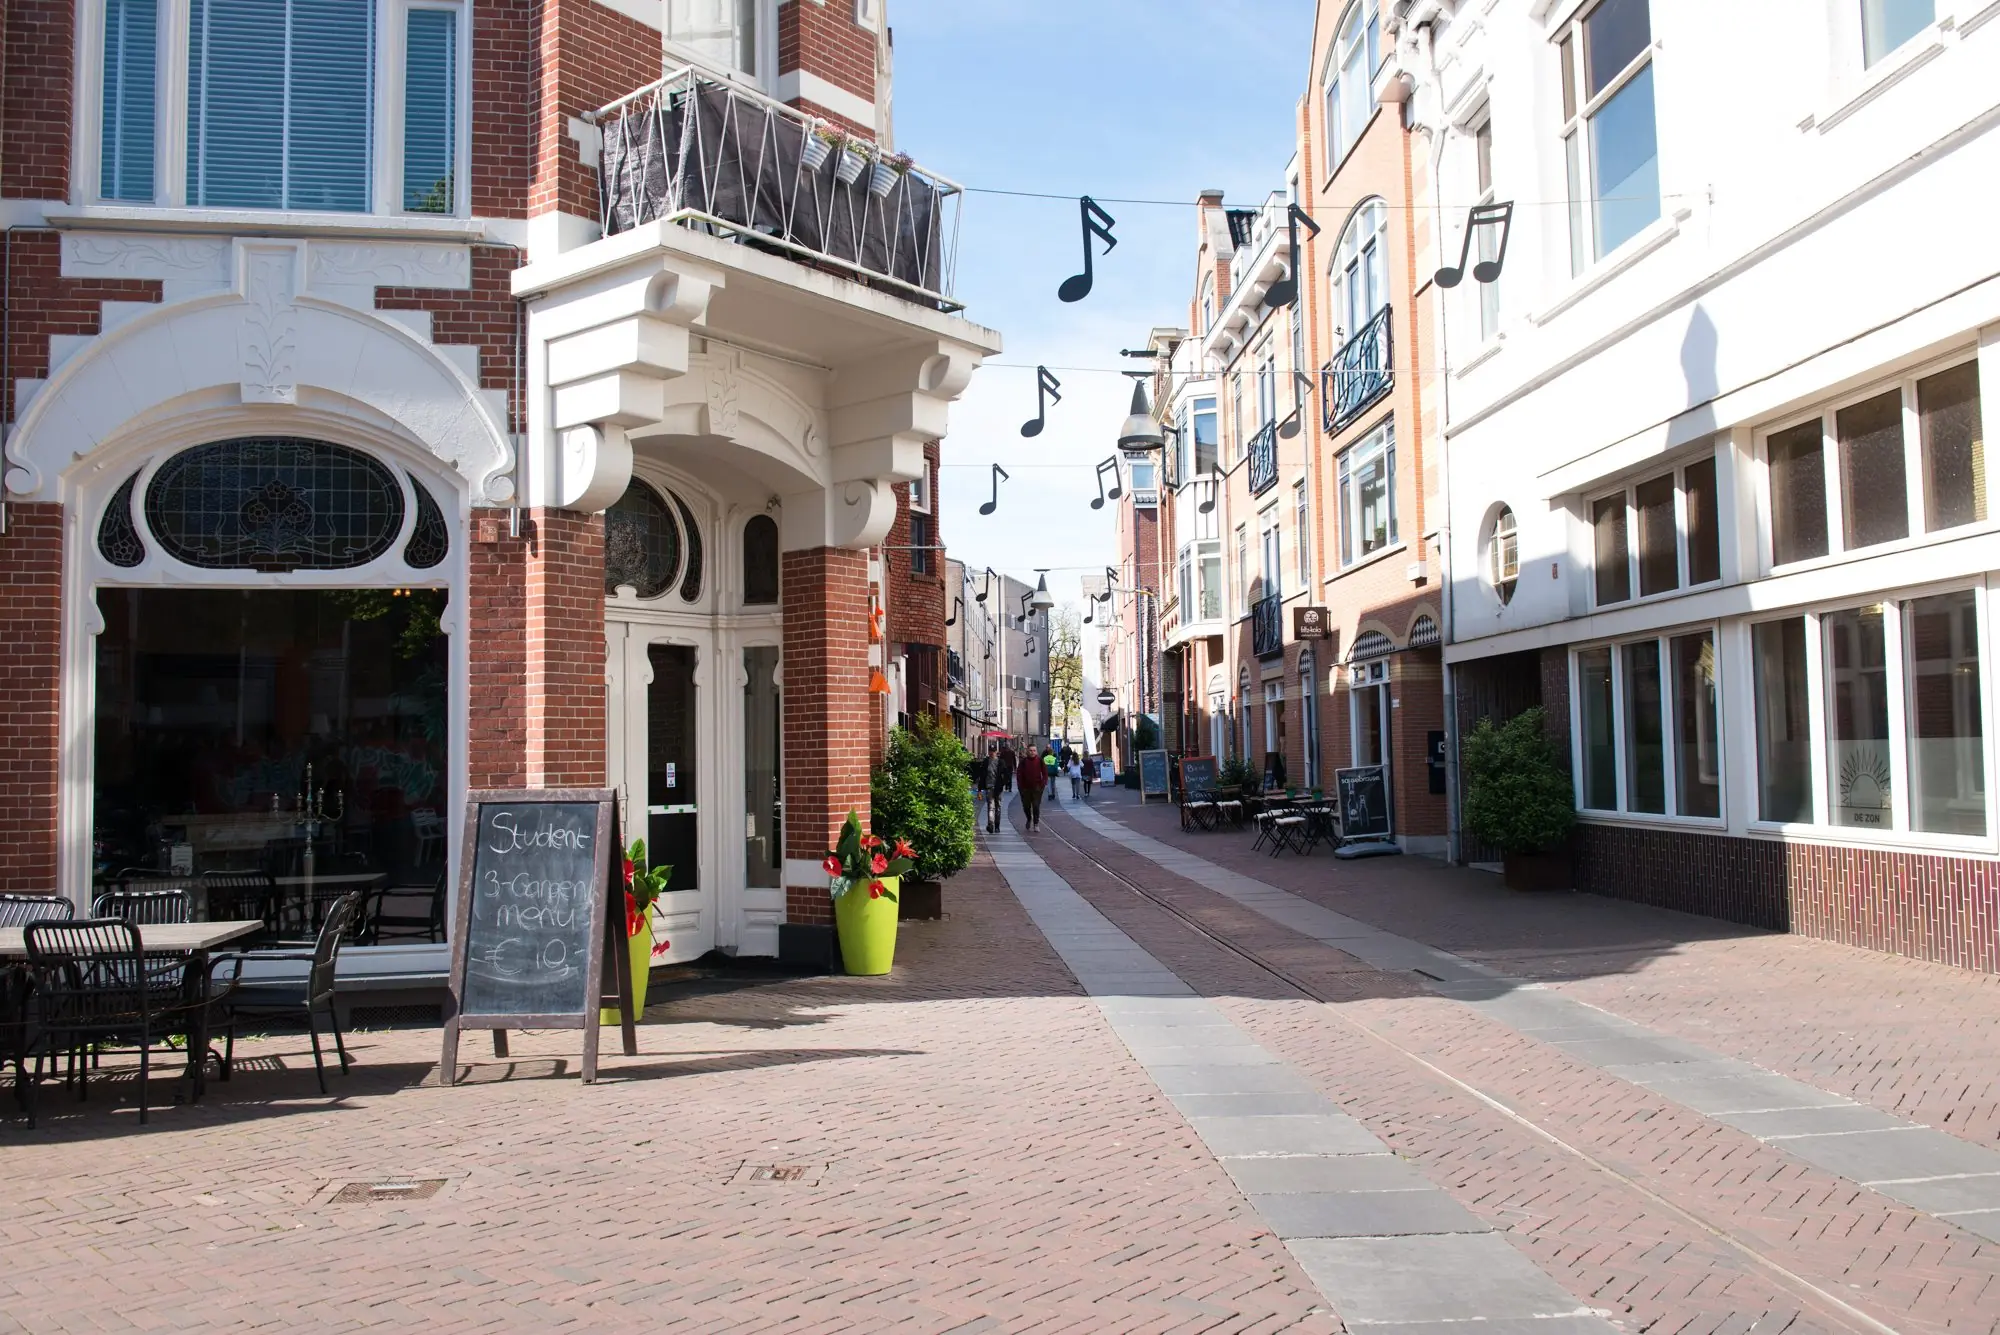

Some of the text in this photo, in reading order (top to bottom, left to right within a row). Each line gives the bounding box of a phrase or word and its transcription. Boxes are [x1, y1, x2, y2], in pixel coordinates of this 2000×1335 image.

[1854, 813, 1880, 823] DE ZON
[489, 812, 591, 854] Student
[497, 904, 575, 931] menu
